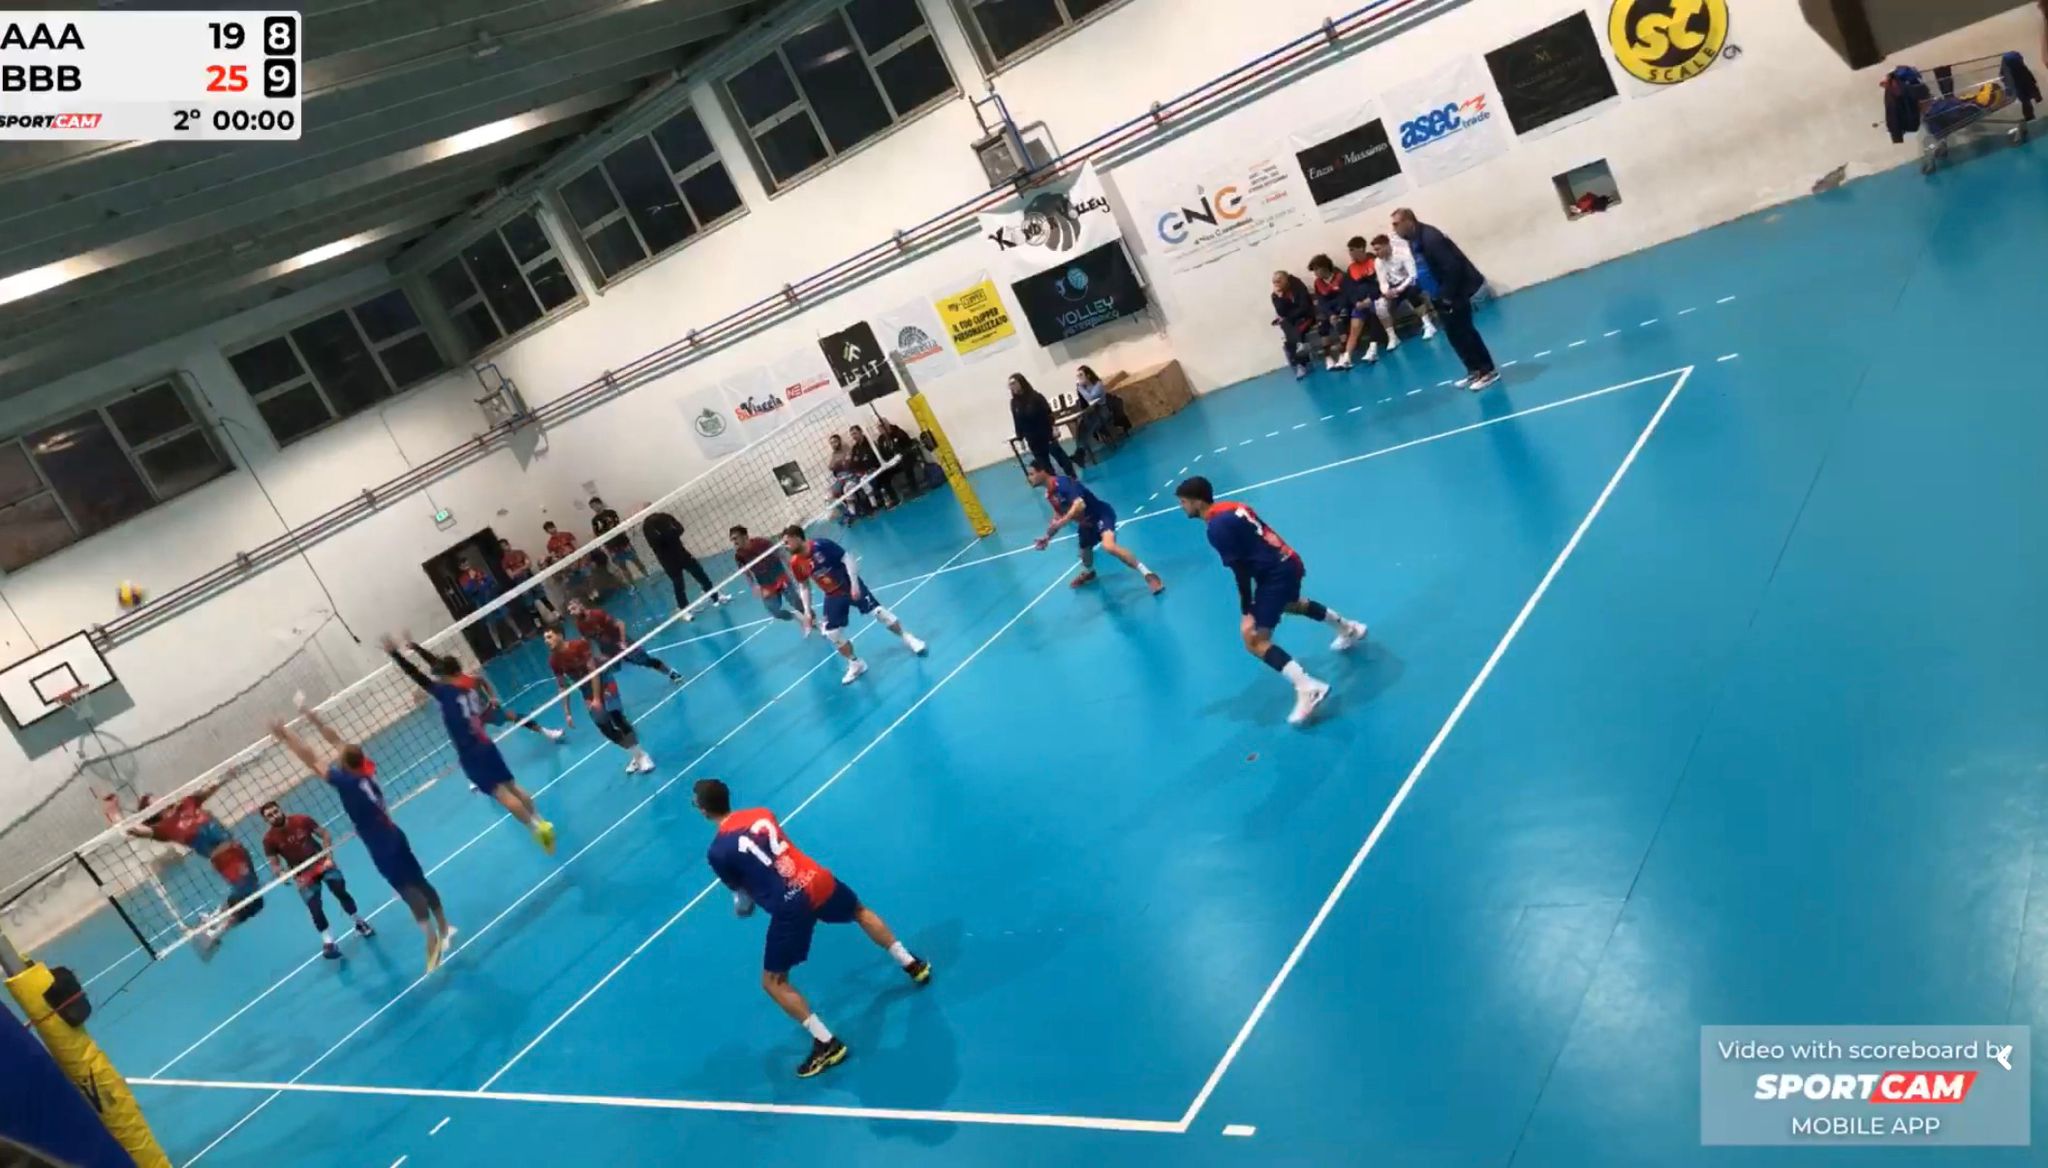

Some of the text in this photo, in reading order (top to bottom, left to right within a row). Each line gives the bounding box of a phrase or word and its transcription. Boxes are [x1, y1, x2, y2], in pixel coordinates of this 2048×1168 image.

[1648, 46, 1716, 81] SCALE
[1399, 102, 1460, 149] asec
[1461, 111, 1490, 128] trade
[1056, 295, 1114, 327] VOLLEY
[738, 818, 789, 867] 12
